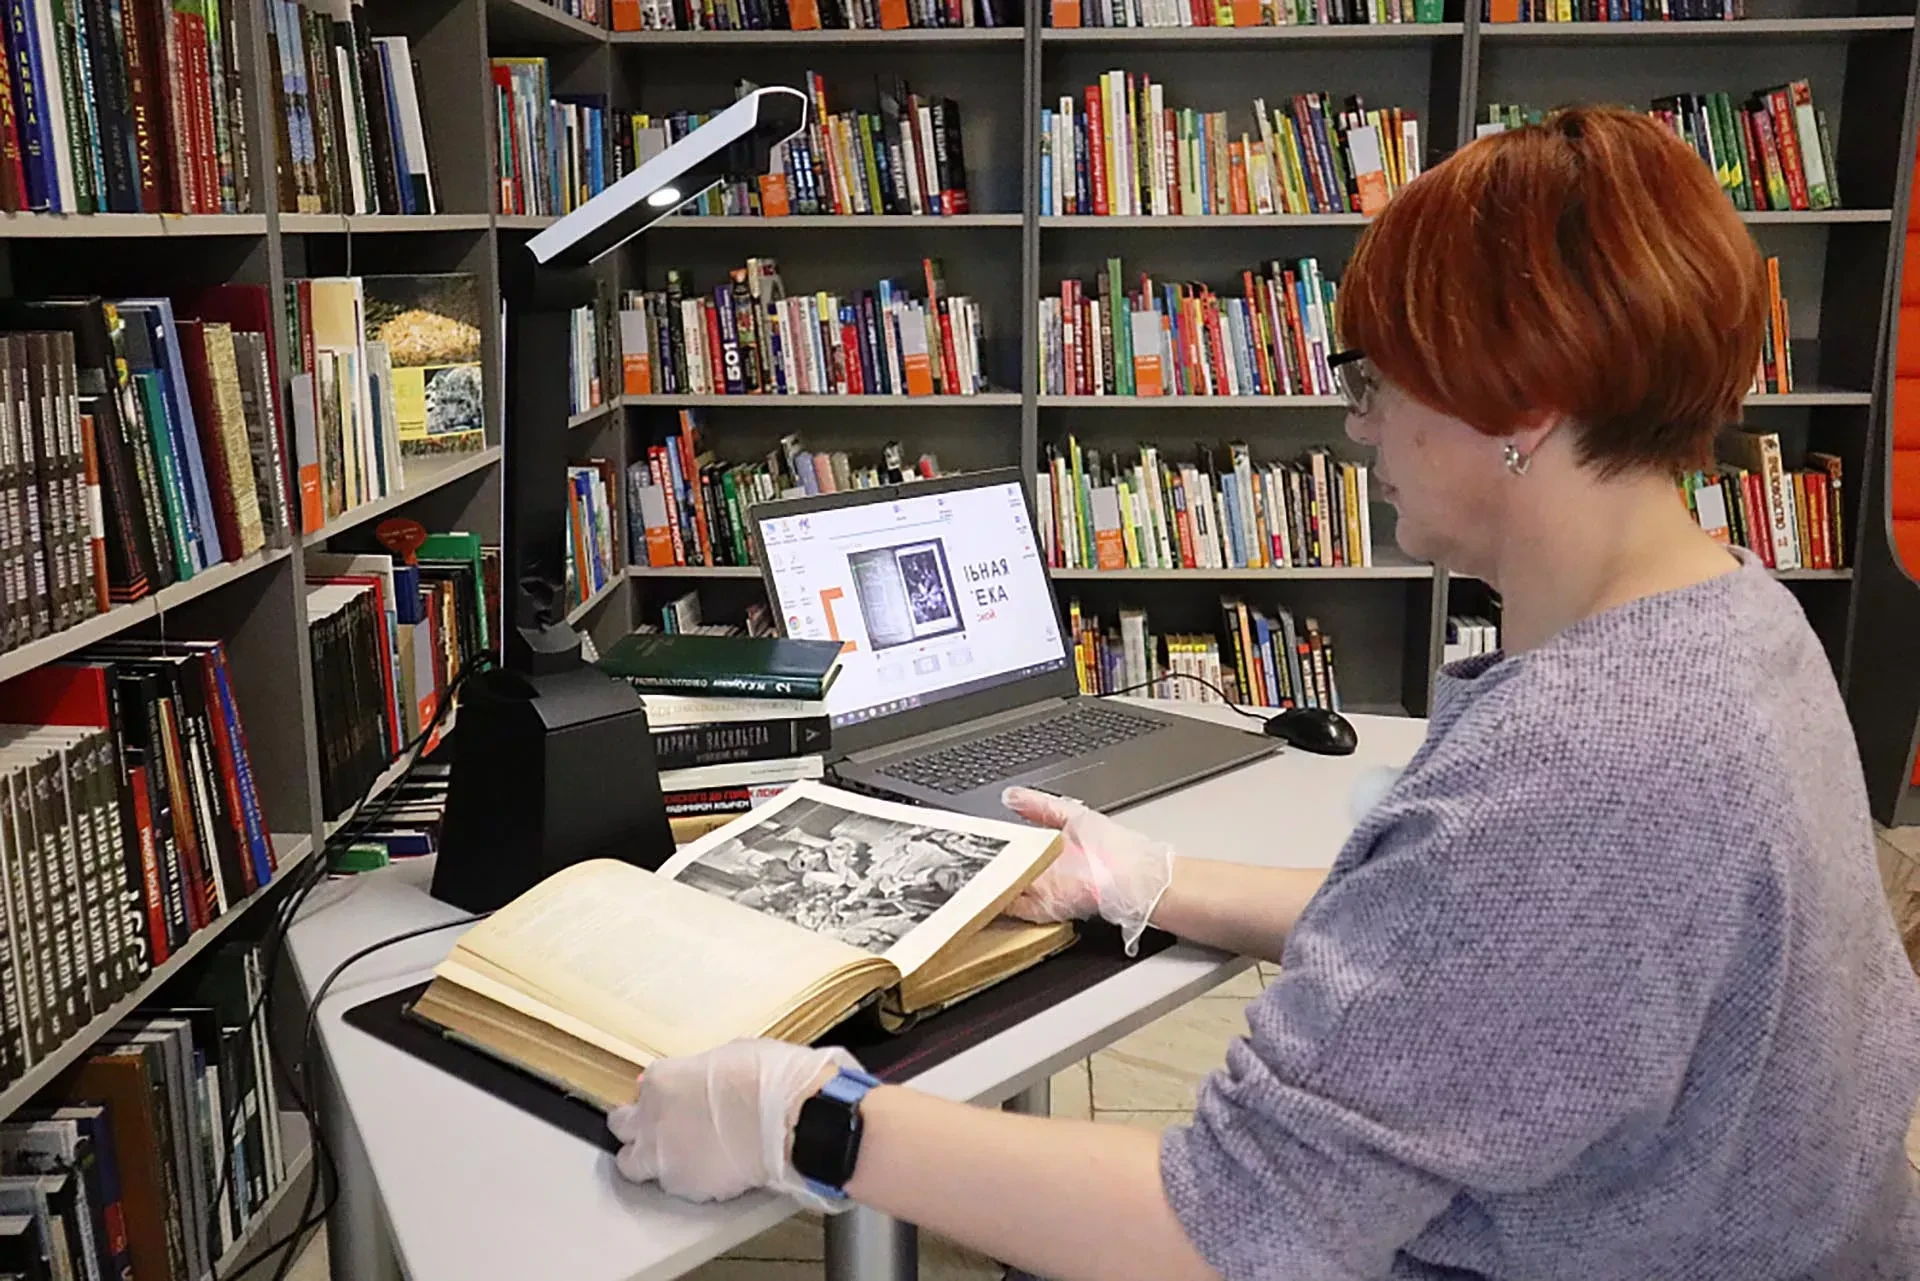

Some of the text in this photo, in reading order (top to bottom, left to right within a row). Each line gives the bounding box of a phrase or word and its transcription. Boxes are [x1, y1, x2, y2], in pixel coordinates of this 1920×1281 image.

[136, 105, 153, 190] ТАТАРЫ
[724, 342, 741, 381] 501
[963, 557, 1010, 582] ЬНАЯ
[970, 585, 1009, 607] ЕКА
[707, 725, 769, 748] ВАСИЛЬЕВА
